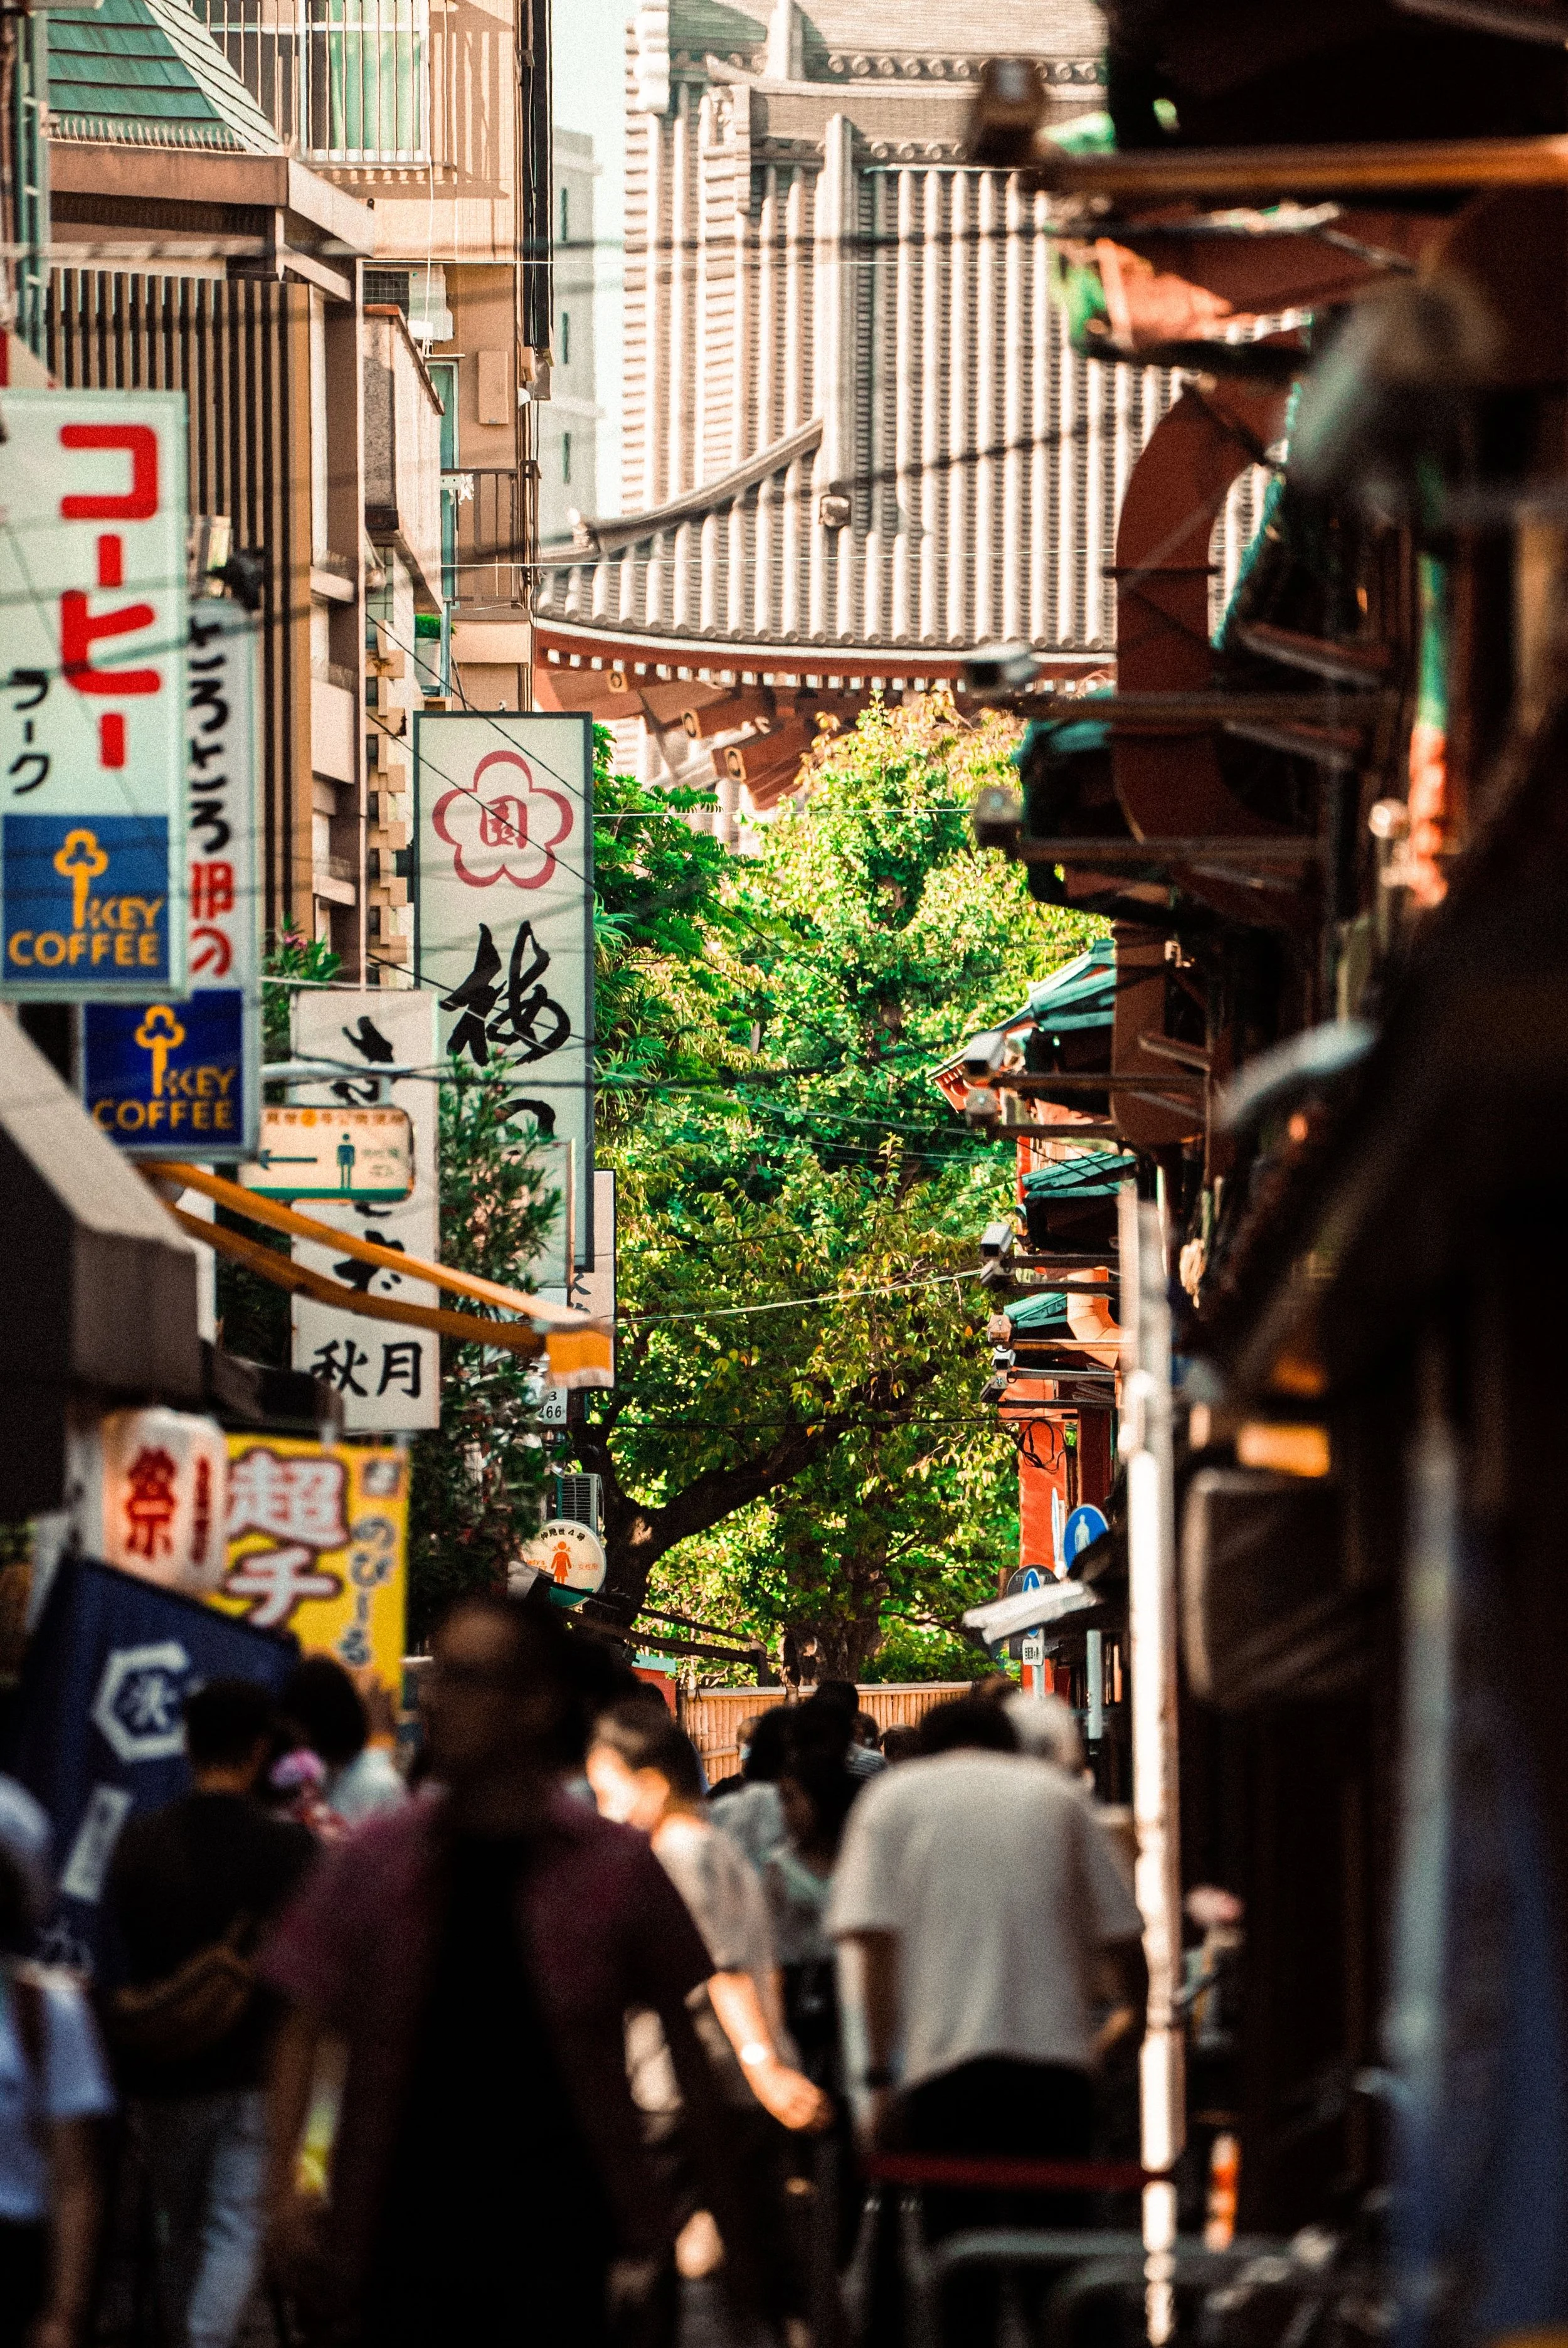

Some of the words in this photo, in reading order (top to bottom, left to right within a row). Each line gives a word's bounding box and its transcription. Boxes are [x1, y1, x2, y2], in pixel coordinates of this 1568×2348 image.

[60, 423, 161, 770] コーヒー
[480, 794, 528, 849] 園
[86, 896, 165, 932] KEY
[8, 931, 160, 967] COFFEE
[162, 1065, 237, 1097] KEY
[92, 1098, 235, 1130] COFFEE
[313, 1339, 423, 1399] 秋月
